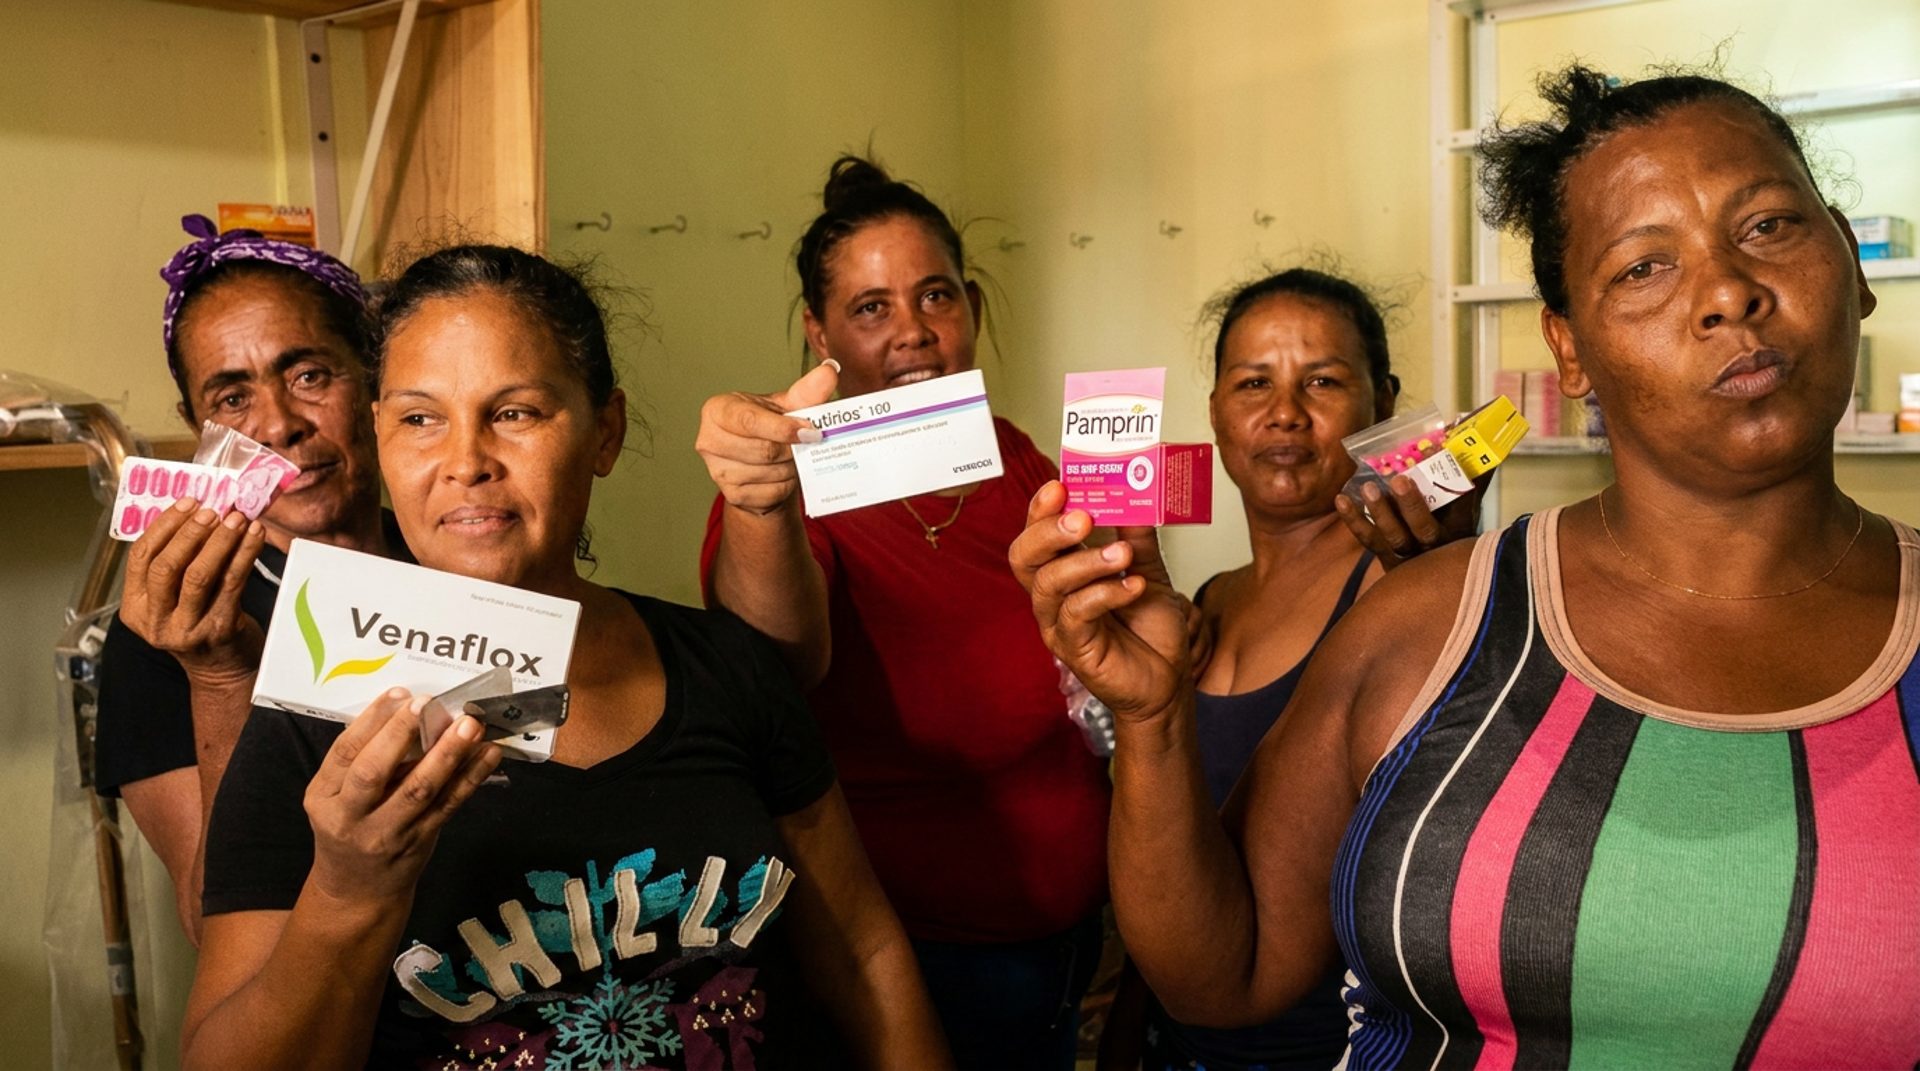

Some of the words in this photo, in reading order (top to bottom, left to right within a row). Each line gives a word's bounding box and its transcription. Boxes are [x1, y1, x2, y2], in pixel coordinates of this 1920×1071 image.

[807, 408, 861, 430] utirios
[1066, 411, 1154, 441] Pamprin
[350, 606, 543, 677] Venaflox
[393, 856, 796, 1023] CHILLY
